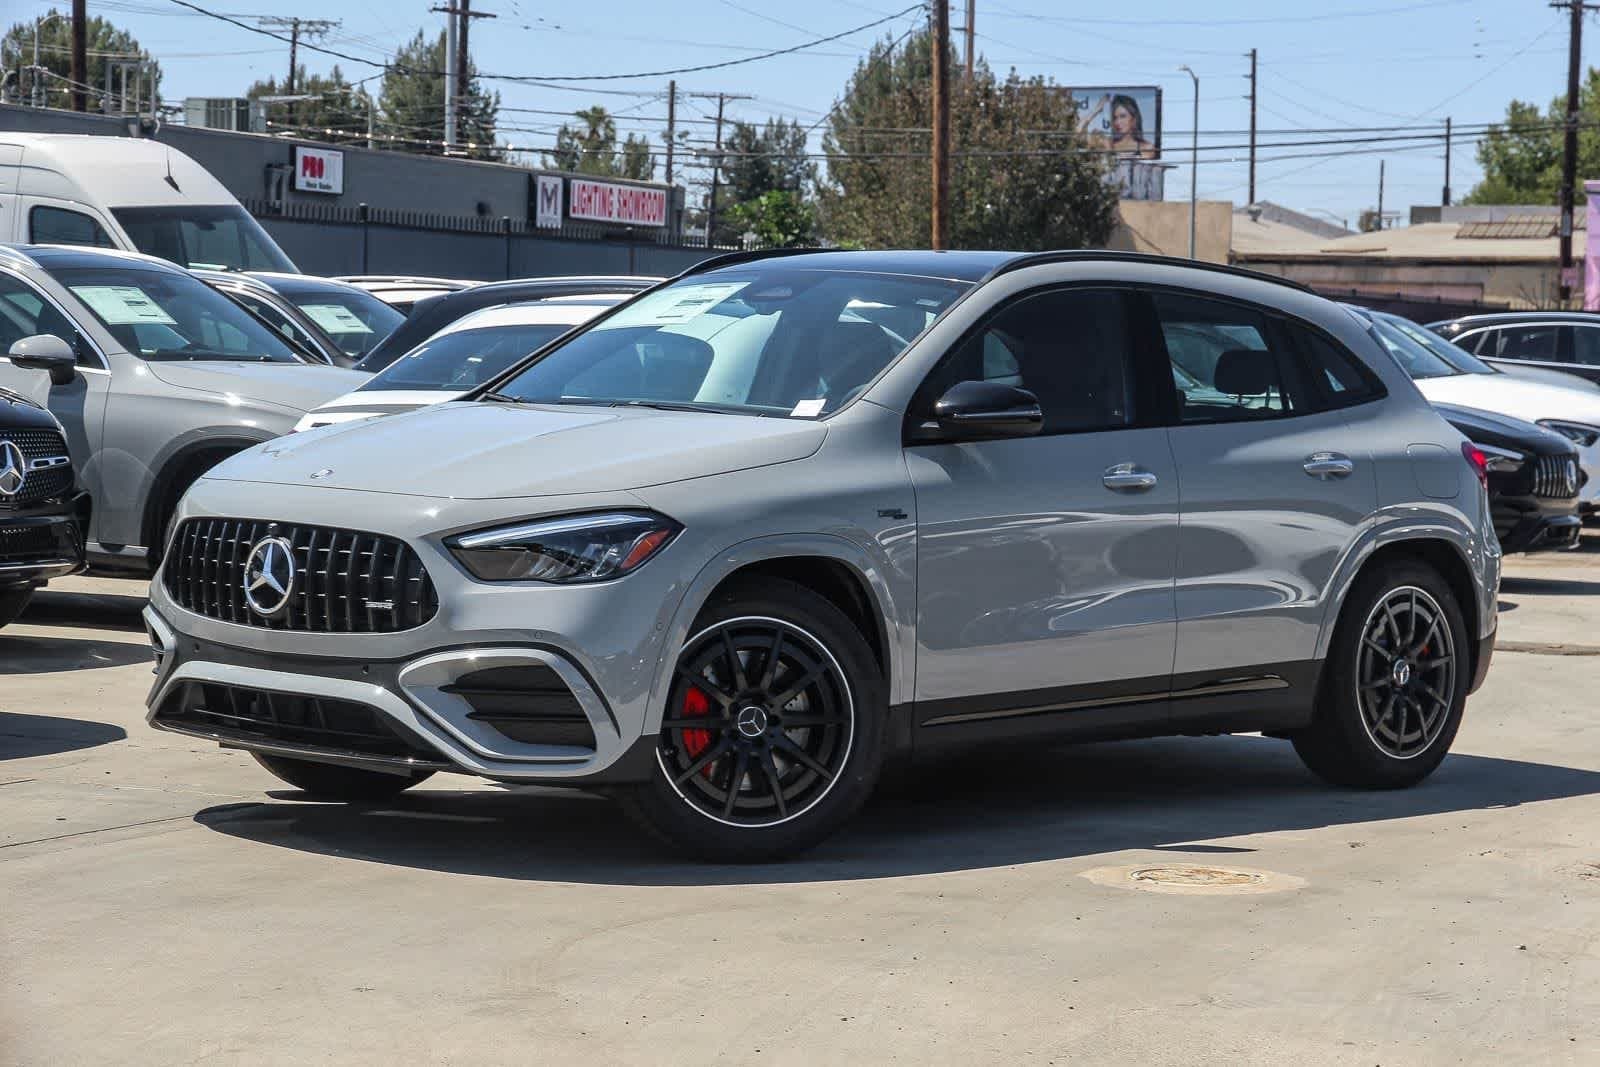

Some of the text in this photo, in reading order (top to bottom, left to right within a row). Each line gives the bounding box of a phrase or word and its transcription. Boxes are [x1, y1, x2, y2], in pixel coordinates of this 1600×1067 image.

[541, 182, 559, 215] M
[572, 182, 665, 222] LIGHTING SHOWROOM
